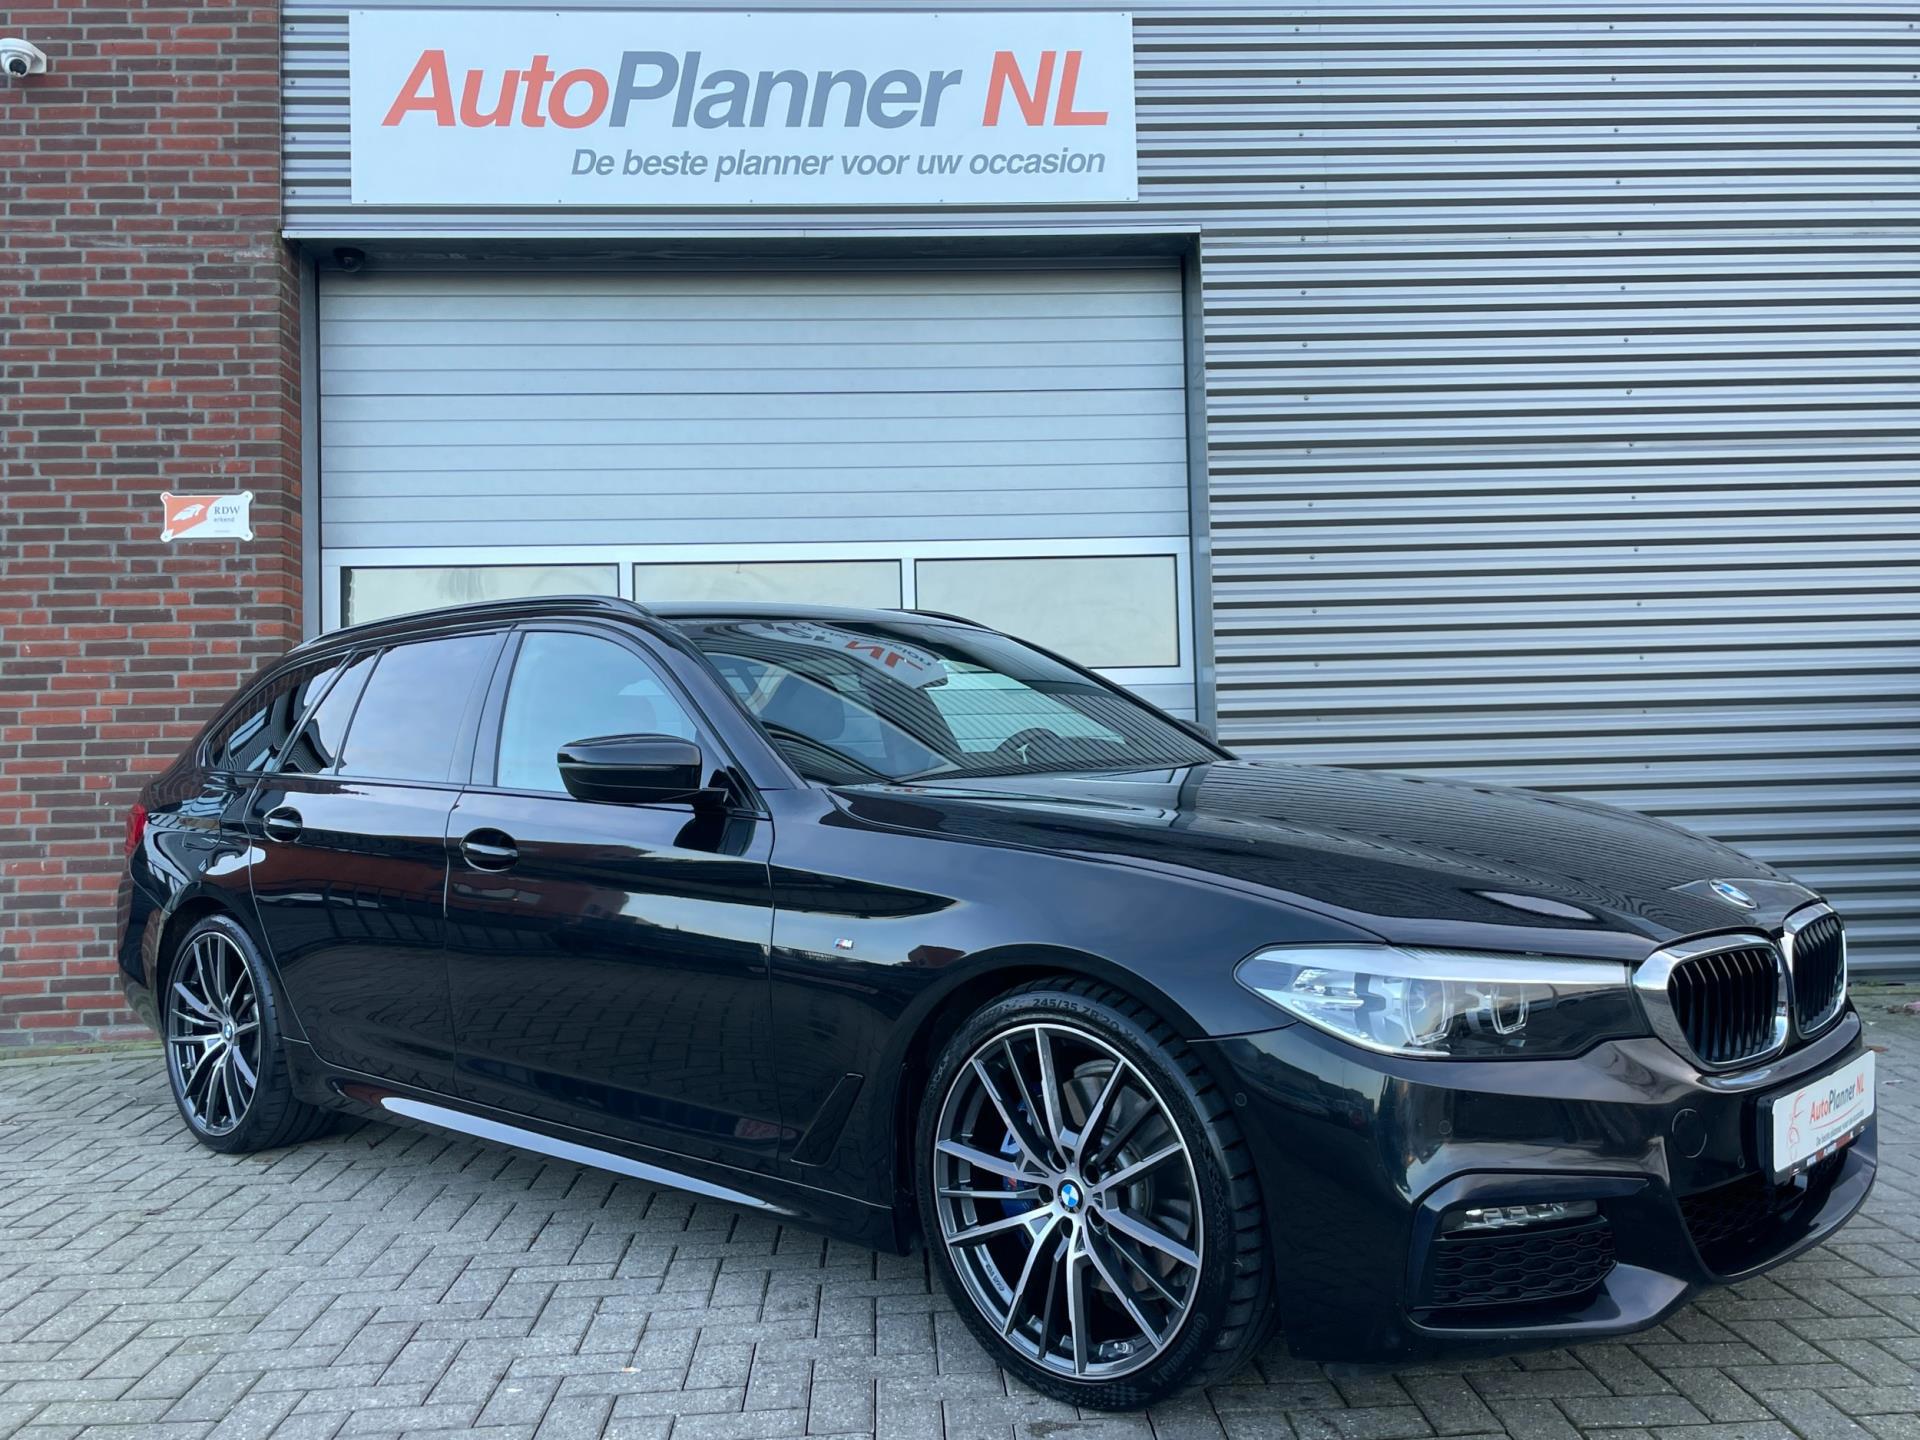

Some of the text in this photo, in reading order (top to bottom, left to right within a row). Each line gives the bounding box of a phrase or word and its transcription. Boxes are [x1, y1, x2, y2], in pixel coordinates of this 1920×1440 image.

[381, 49, 1109, 129] AutoPlanner NL
[571, 147, 1106, 182] De beste planner voor uw occasion
[214, 505, 240, 514] RDW
[1032, 998, 1079, 1011] 245/35
[1810, 1083, 1856, 1123] AutoPlanner
